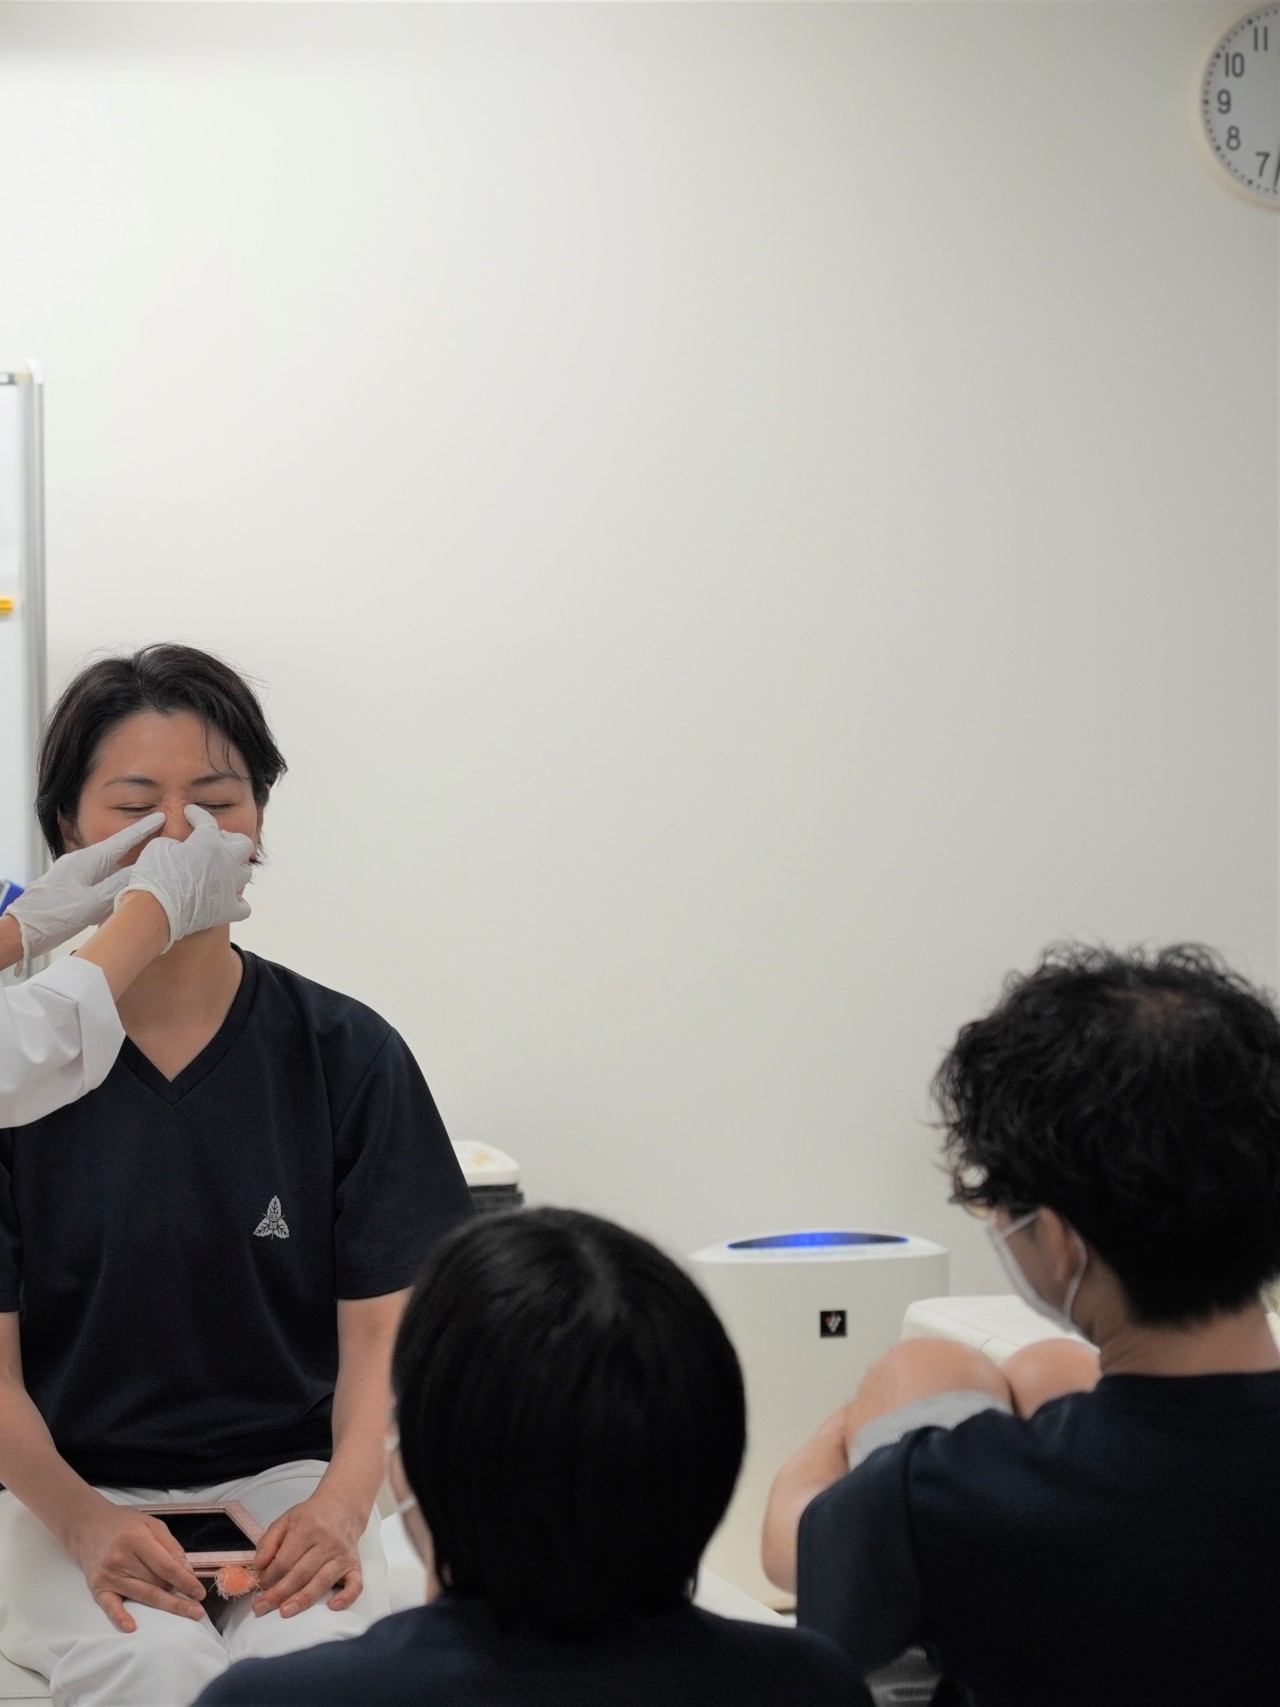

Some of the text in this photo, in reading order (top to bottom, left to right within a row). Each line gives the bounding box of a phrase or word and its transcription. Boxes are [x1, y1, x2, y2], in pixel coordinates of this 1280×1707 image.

[1253, 25, 1269, 52] 11
[1225, 51, 1245, 78] 10
[1217, 88, 1232, 115] 9
[1226, 125, 1241, 151] 8
[1255, 151, 1270, 178] 7
